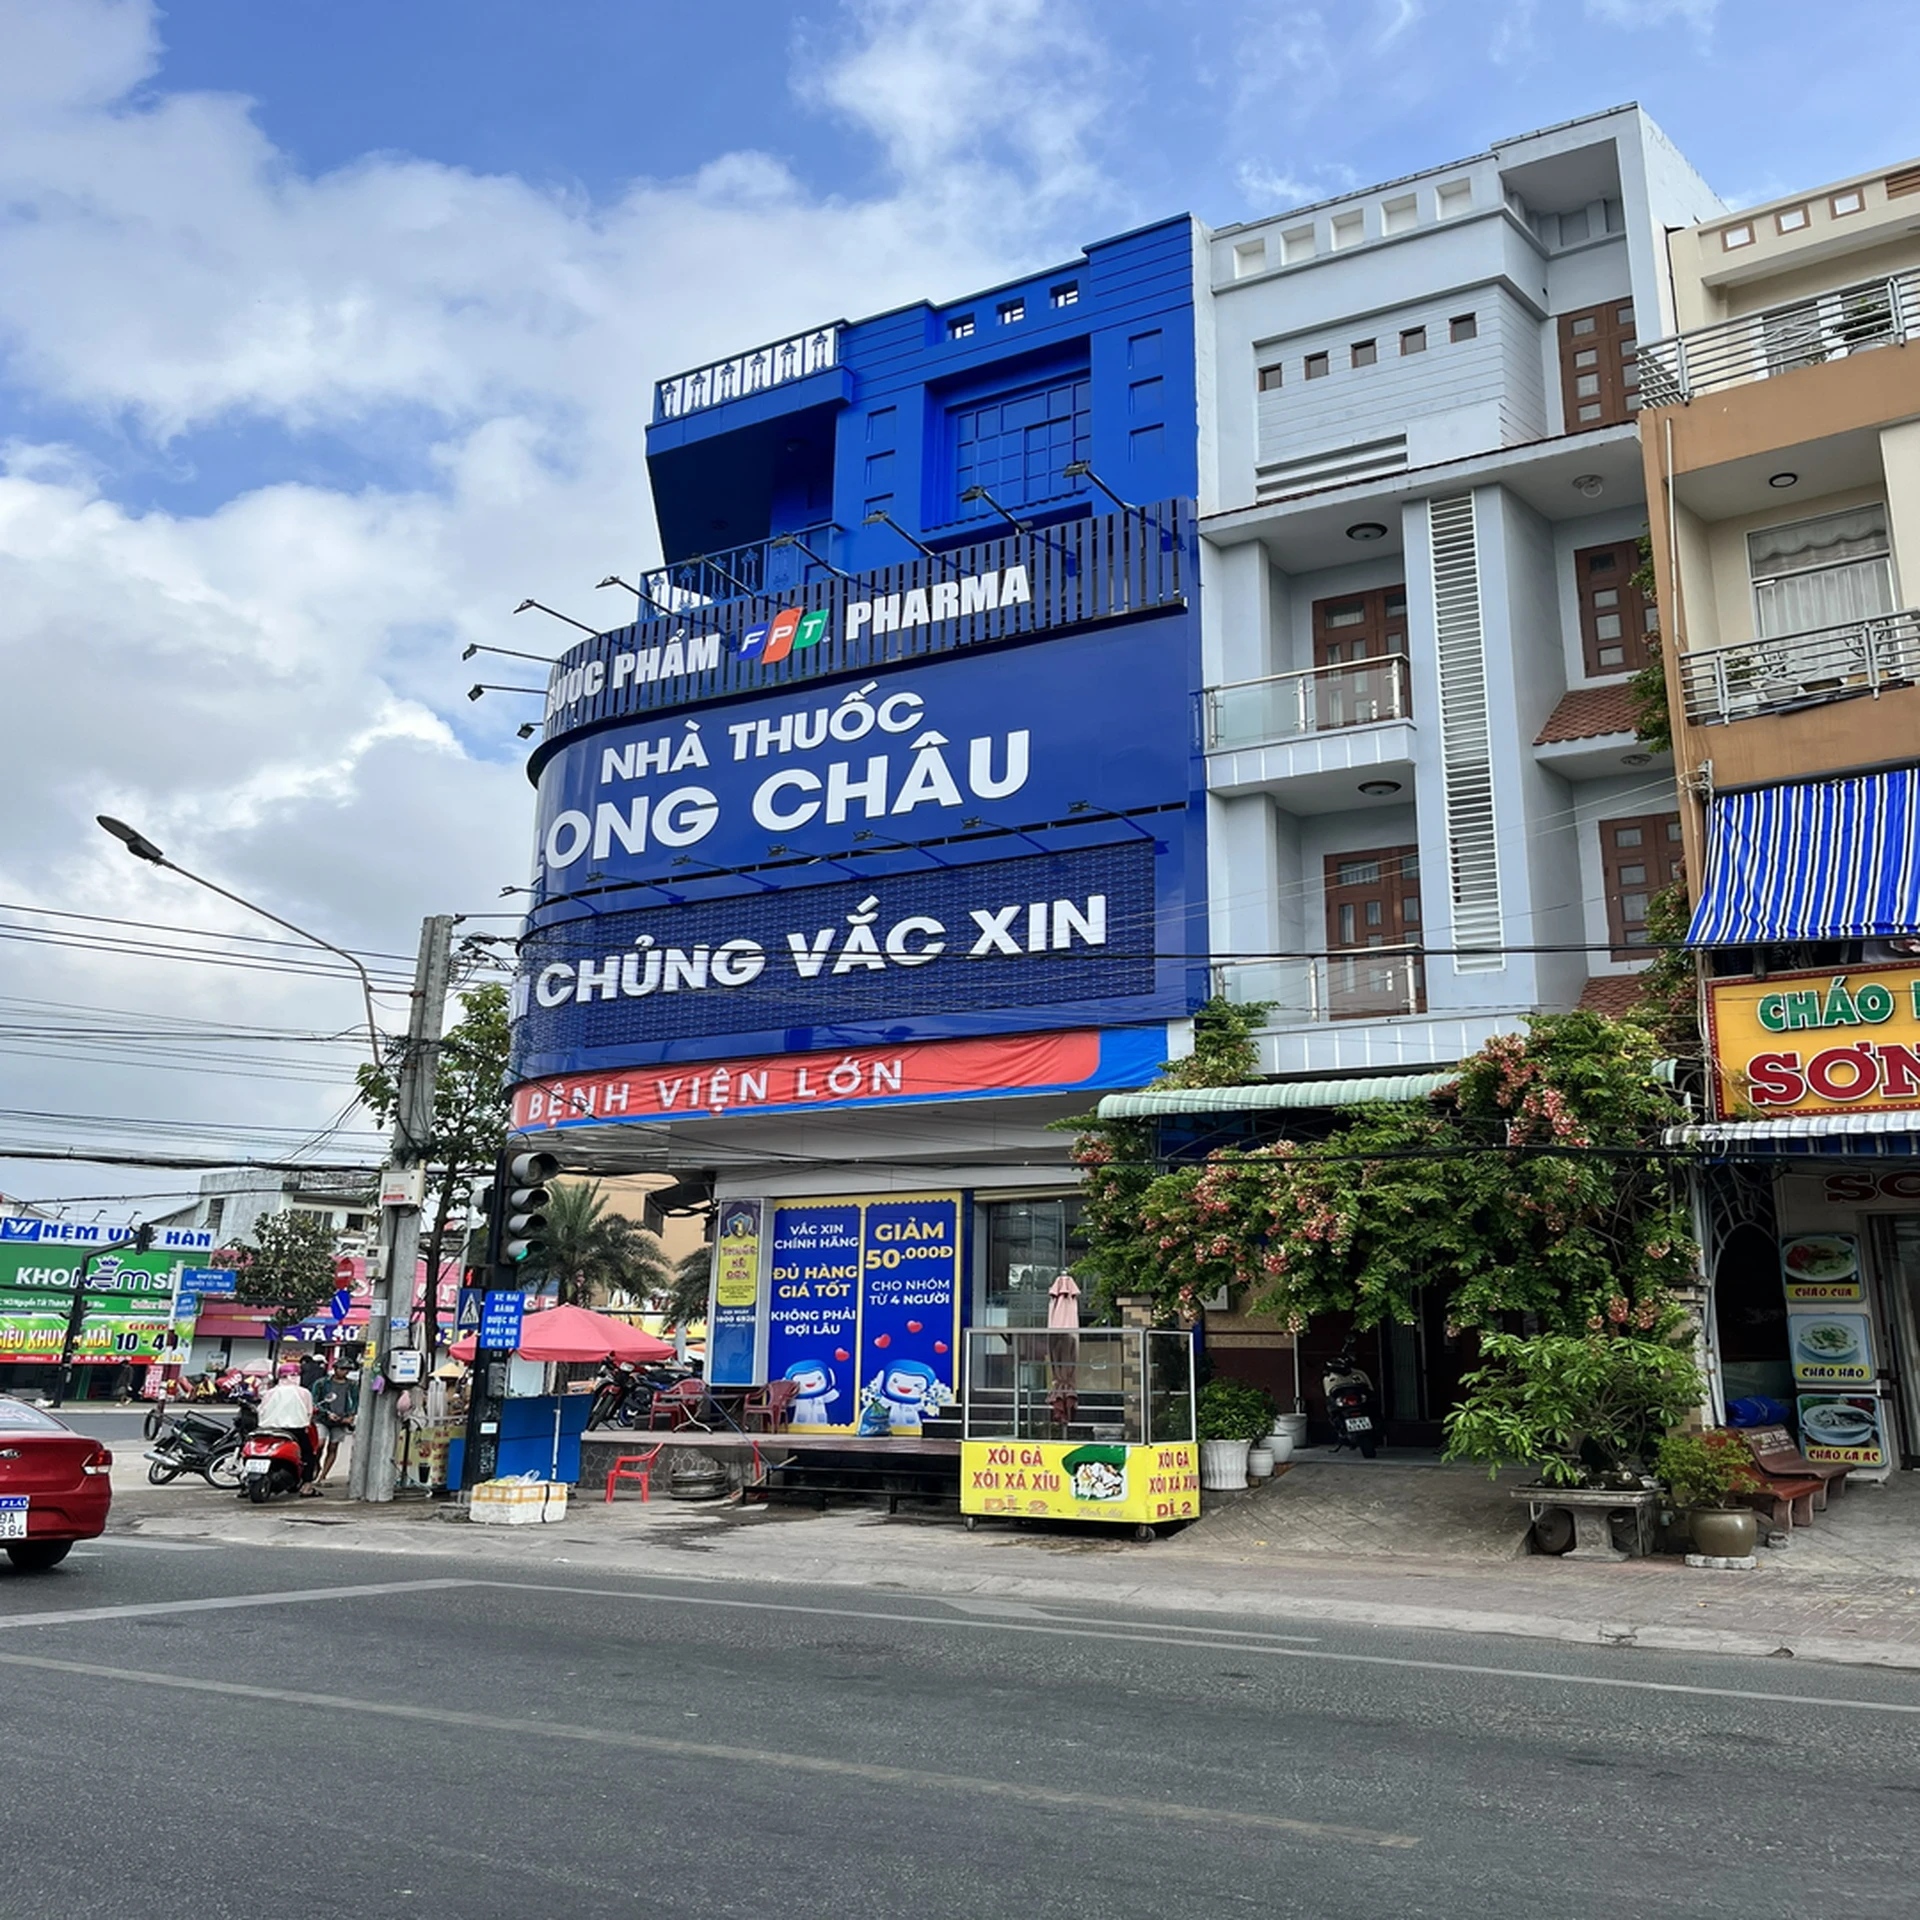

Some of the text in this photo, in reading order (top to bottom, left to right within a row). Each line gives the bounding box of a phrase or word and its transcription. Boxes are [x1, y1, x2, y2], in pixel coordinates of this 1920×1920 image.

[612, 630, 720, 690] PHẨM
[739, 614, 826, 657] FPT
[846, 565, 1031, 641] PHARMA
[600, 682, 925, 784] NHÀ THUỐC
[753, 731, 1030, 831] CHÂU
[536, 935, 765, 1008] CHỦNG
[787, 896, 946, 978] VẮC
[967, 894, 1107, 956] XIN
[1757, 976, 1895, 1032] CHÁO
[528, 1057, 903, 1127] BỆNH VIỆN LỚN
[43, 1222, 98, 1242] NỆM
[166, 1228, 211, 1247] HÀN
[790, 1222, 844, 1236] VẮC XIN
[874, 1216, 945, 1243] GIẢM
[774, 1236, 859, 1250] CHÍNH HÃNG
[16, 1266, 70, 1285] KHO
[773, 1262, 858, 1281] ĐỦ HÀNG
[778, 1280, 851, 1299] GIÁ TỐT
[872, 1278, 950, 1292] CHO NHÓM
[1830, 1287, 1853, 1297] CUA
[869, 1293, 950, 1306] TỪ 4 NGƯỜI
[771, 1307, 856, 1322] KHÔNG PHẢI
[302, 1324, 360, 1341] TÃ SỮ
[785, 1322, 841, 1337] ĐỢI LÂU
[116, 1332, 139, 1351] 10
[988, 1445, 1043, 1466] XÔI GÀ
[1158, 1446, 1190, 1469] XÔI GÀ
[973, 1468, 999, 1488] XÔI
[1149, 1473, 1166, 1495] XÔI
[1028, 1499, 1049, 1514] 2
[1181, 1501, 1192, 1516] 2
